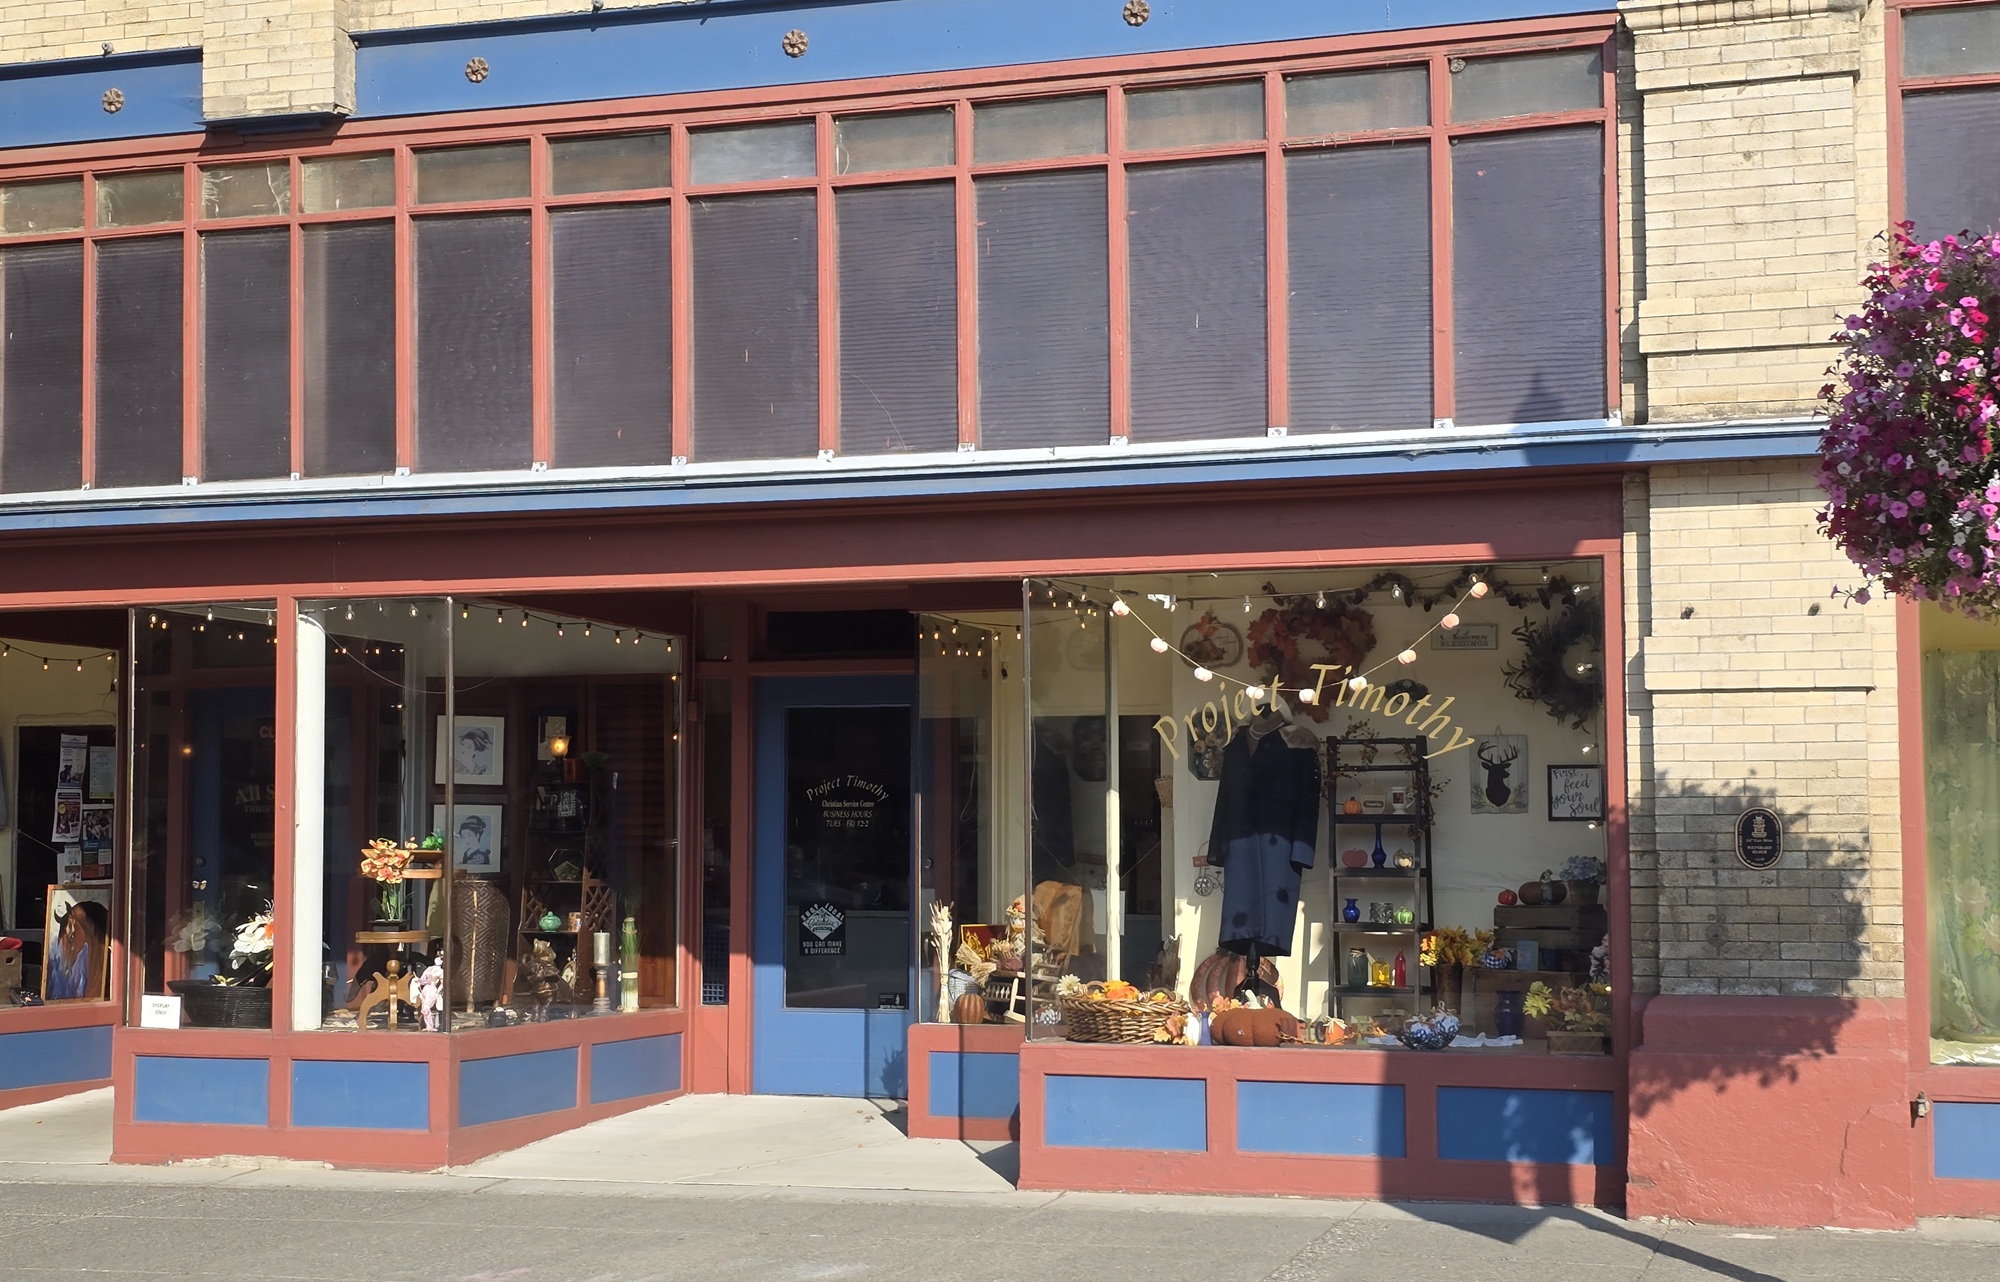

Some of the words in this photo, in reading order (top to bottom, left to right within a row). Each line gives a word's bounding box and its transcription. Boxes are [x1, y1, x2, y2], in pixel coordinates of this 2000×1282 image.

[1153, 674, 1285, 760] Project
[1309, 663, 1476, 760] Timothy
[806, 777, 841, 802] Project
[846, 774, 890, 802] Timothy
[1564, 773, 1591, 794] feed
[821, 800, 842, 808] Christian
[843, 800, 859, 808] Service
[860, 800, 875, 808] Center
[1551, 791, 1585, 810] your
[1569, 797, 1601, 818] soul
[823, 810, 850, 818] BUSINESS
[850, 810, 873, 818] HOURS
[826, 819, 842, 828] TUES
[846, 819, 856, 828] FRI
[800, 903, 819, 921] SHOP
[824, 902, 845, 921] LOCAL
[827, 940, 842, 948] MAKE
